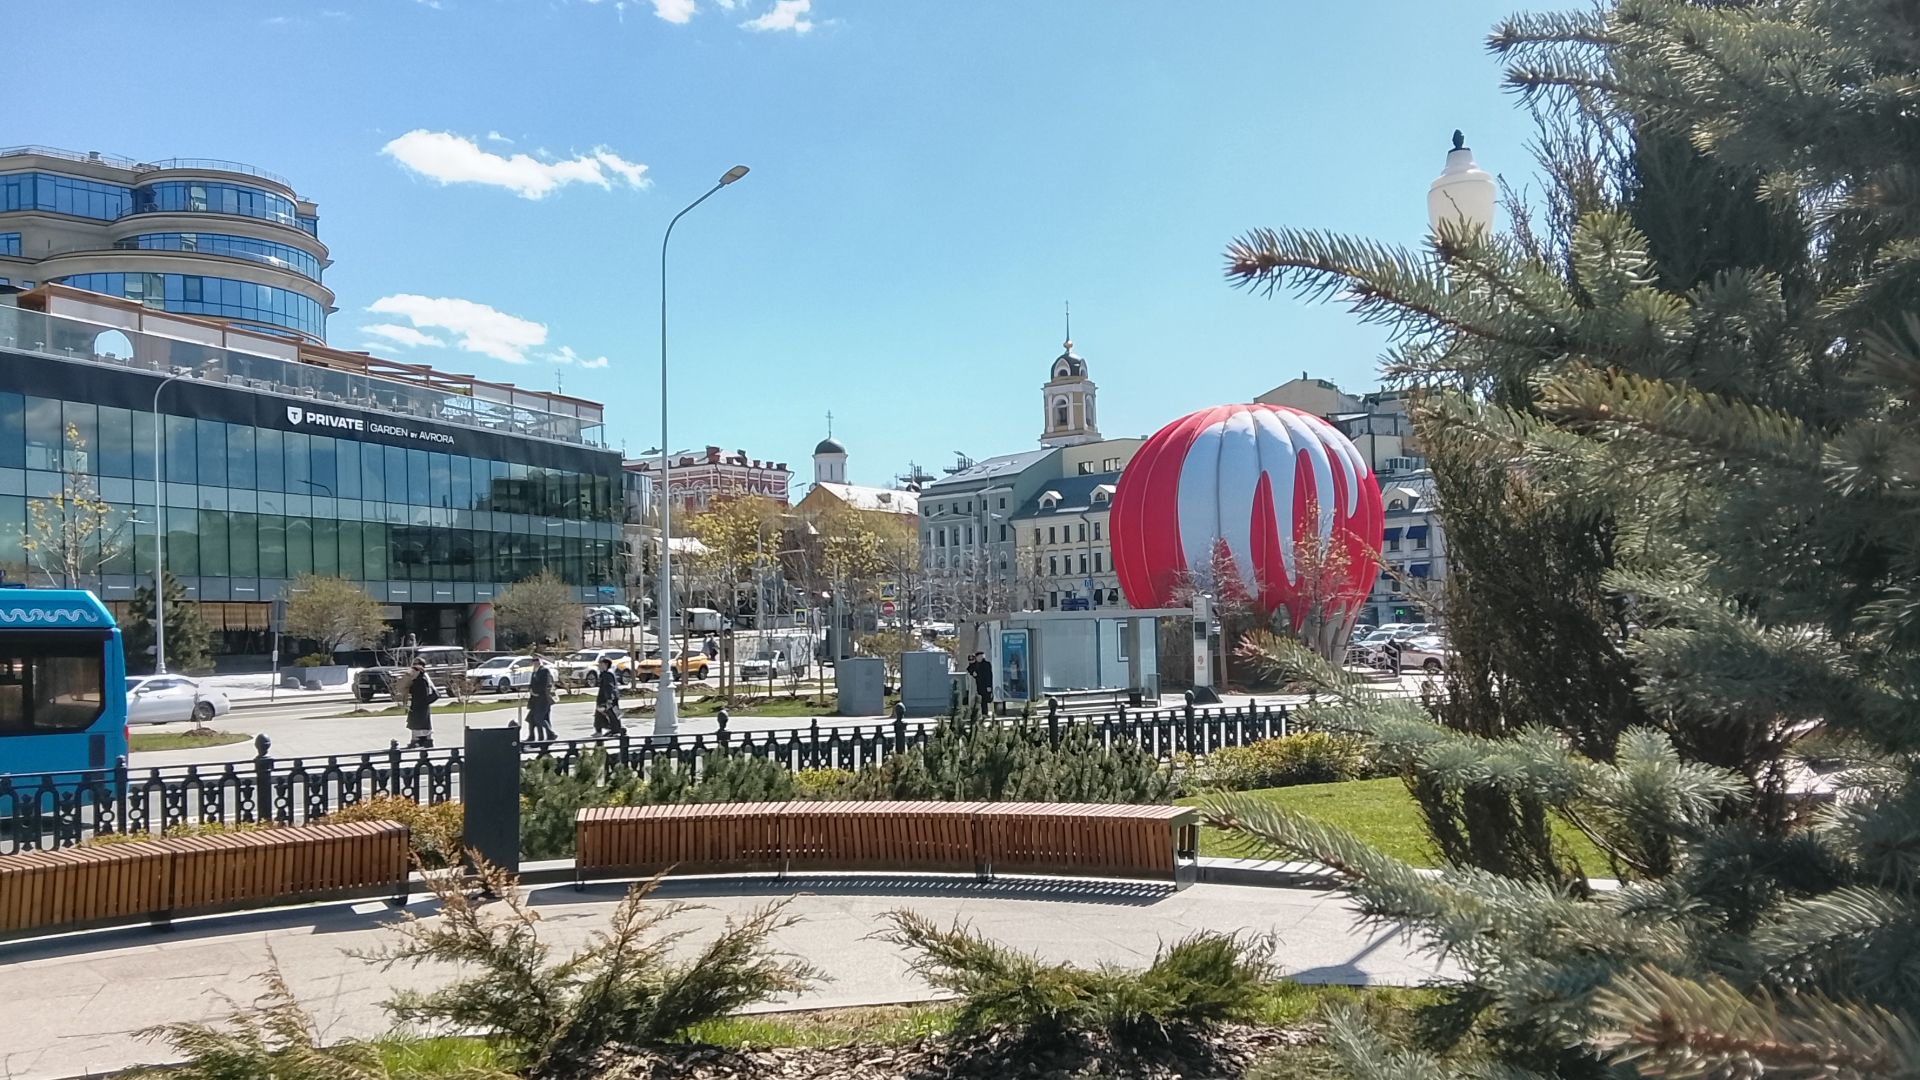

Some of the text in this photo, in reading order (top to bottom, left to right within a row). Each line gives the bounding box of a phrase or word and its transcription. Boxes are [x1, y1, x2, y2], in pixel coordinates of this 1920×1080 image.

[306, 412, 364, 431] PRIVATE
[370, 423, 408, 437] GARDEN
[419, 431, 455, 445] AVRORA
